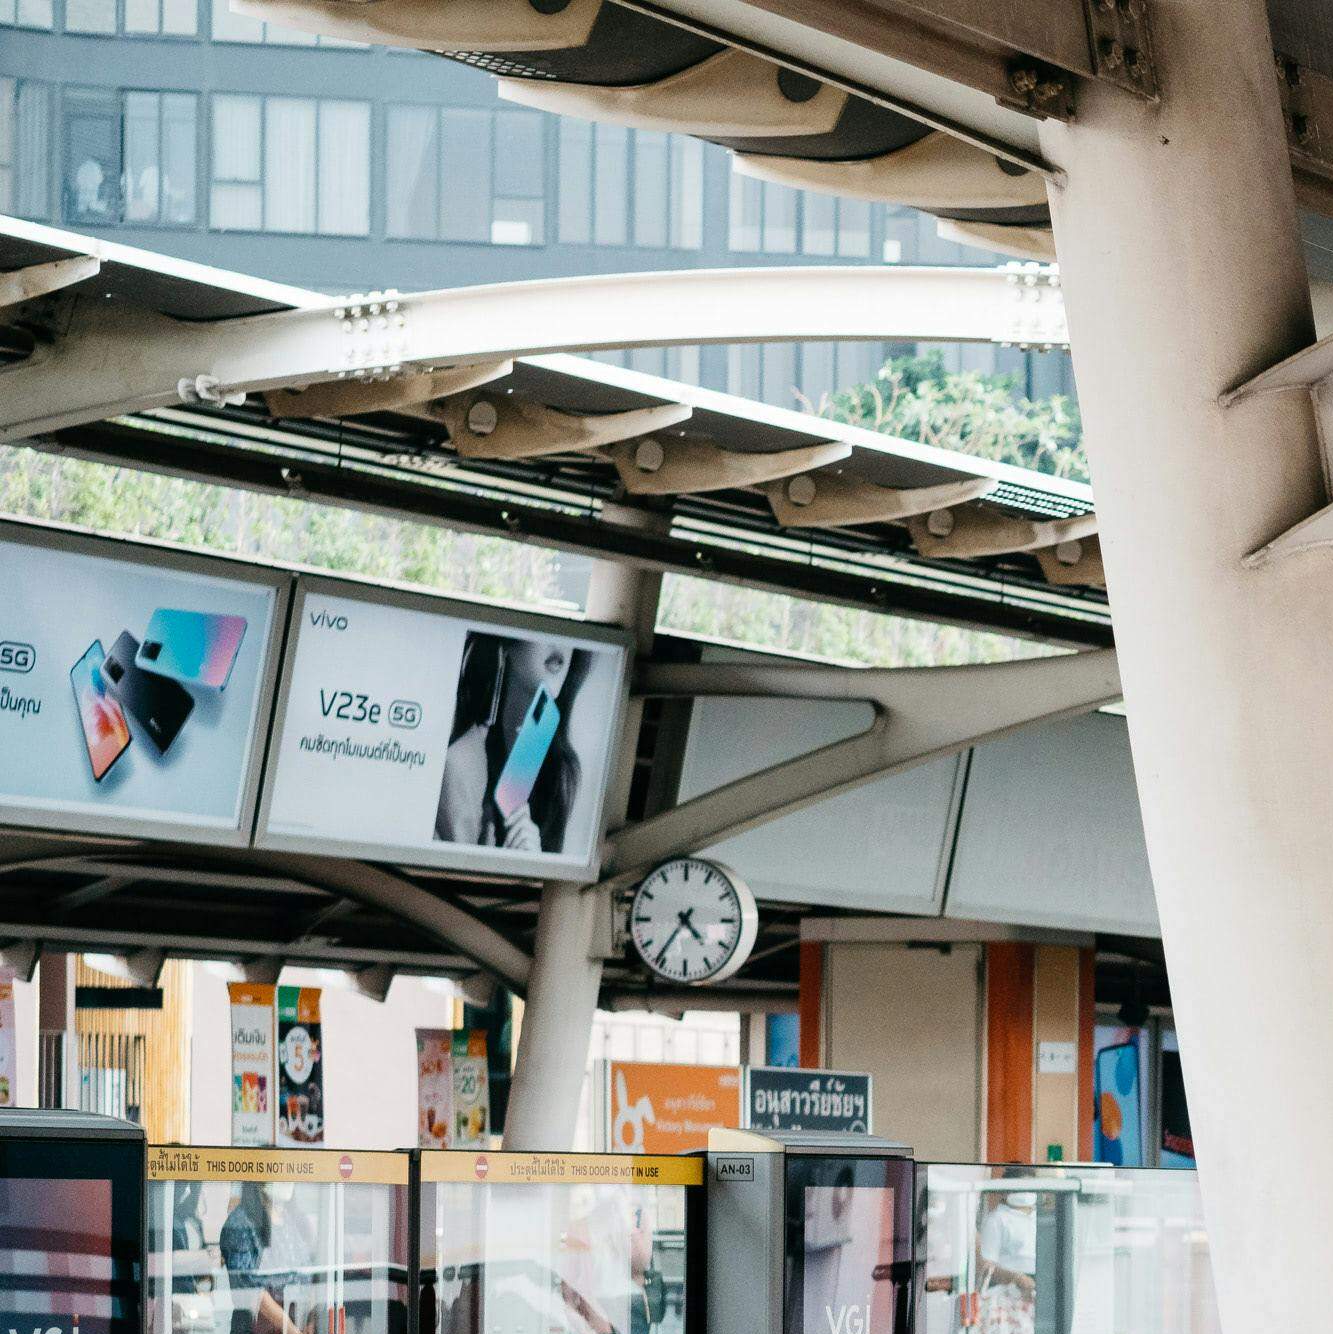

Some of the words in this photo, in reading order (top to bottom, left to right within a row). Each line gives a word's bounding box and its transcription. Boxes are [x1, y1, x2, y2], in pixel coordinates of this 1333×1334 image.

[310, 610, 348, 631] vivo
[0, 648, 29, 666] 5G
[320, 688, 382, 724] V23e
[393, 706, 416, 723] 5G
[206, 1160, 226, 1173] THIS
[228, 1160, 254, 1173] DOOR
[256, 1161, 264, 1173] IS
[266, 1162, 284, 1173] NOT
[286, 1162, 295, 1173] IN
[297, 1162, 314, 1174] USE
[571, 1165, 588, 1176] THIS
[589, 1166, 610, 1177] DOOR
[611, 1166, 618, 1177] IS
[620, 1167, 634, 1177] NOT
[636, 1167, 644, 1178] IN
[645, 1167, 659, 1178] USE
[720, 1165, 751, 1176] AN-03
